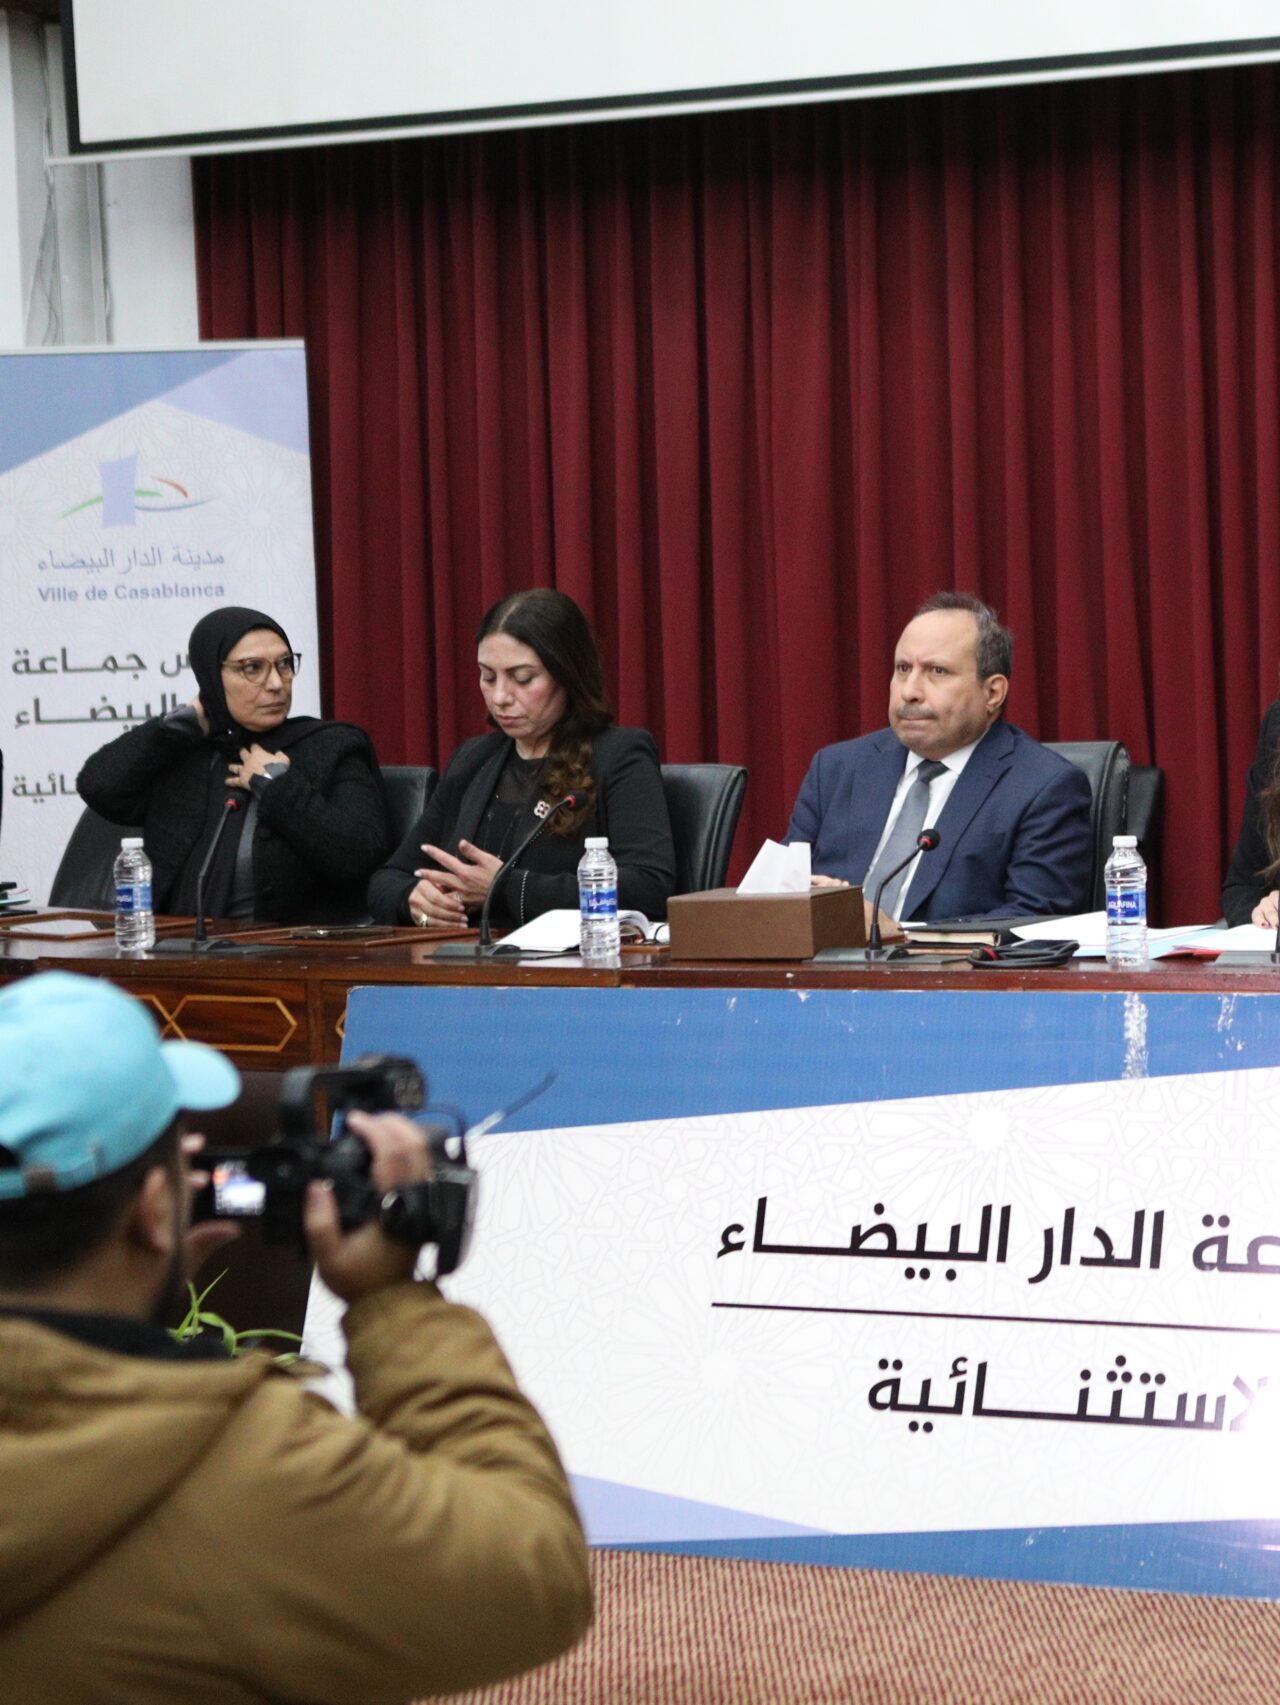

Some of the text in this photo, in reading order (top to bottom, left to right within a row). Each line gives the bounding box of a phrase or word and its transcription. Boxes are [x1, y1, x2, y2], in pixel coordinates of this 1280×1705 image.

[38, 546, 225, 574] مدينة الدار البيضاء
[38, 583, 225, 602] Ville de Casablanca
[716, 1196, 1012, 1283] البيضاء
[1027, 1206, 1165, 1285] الدار
